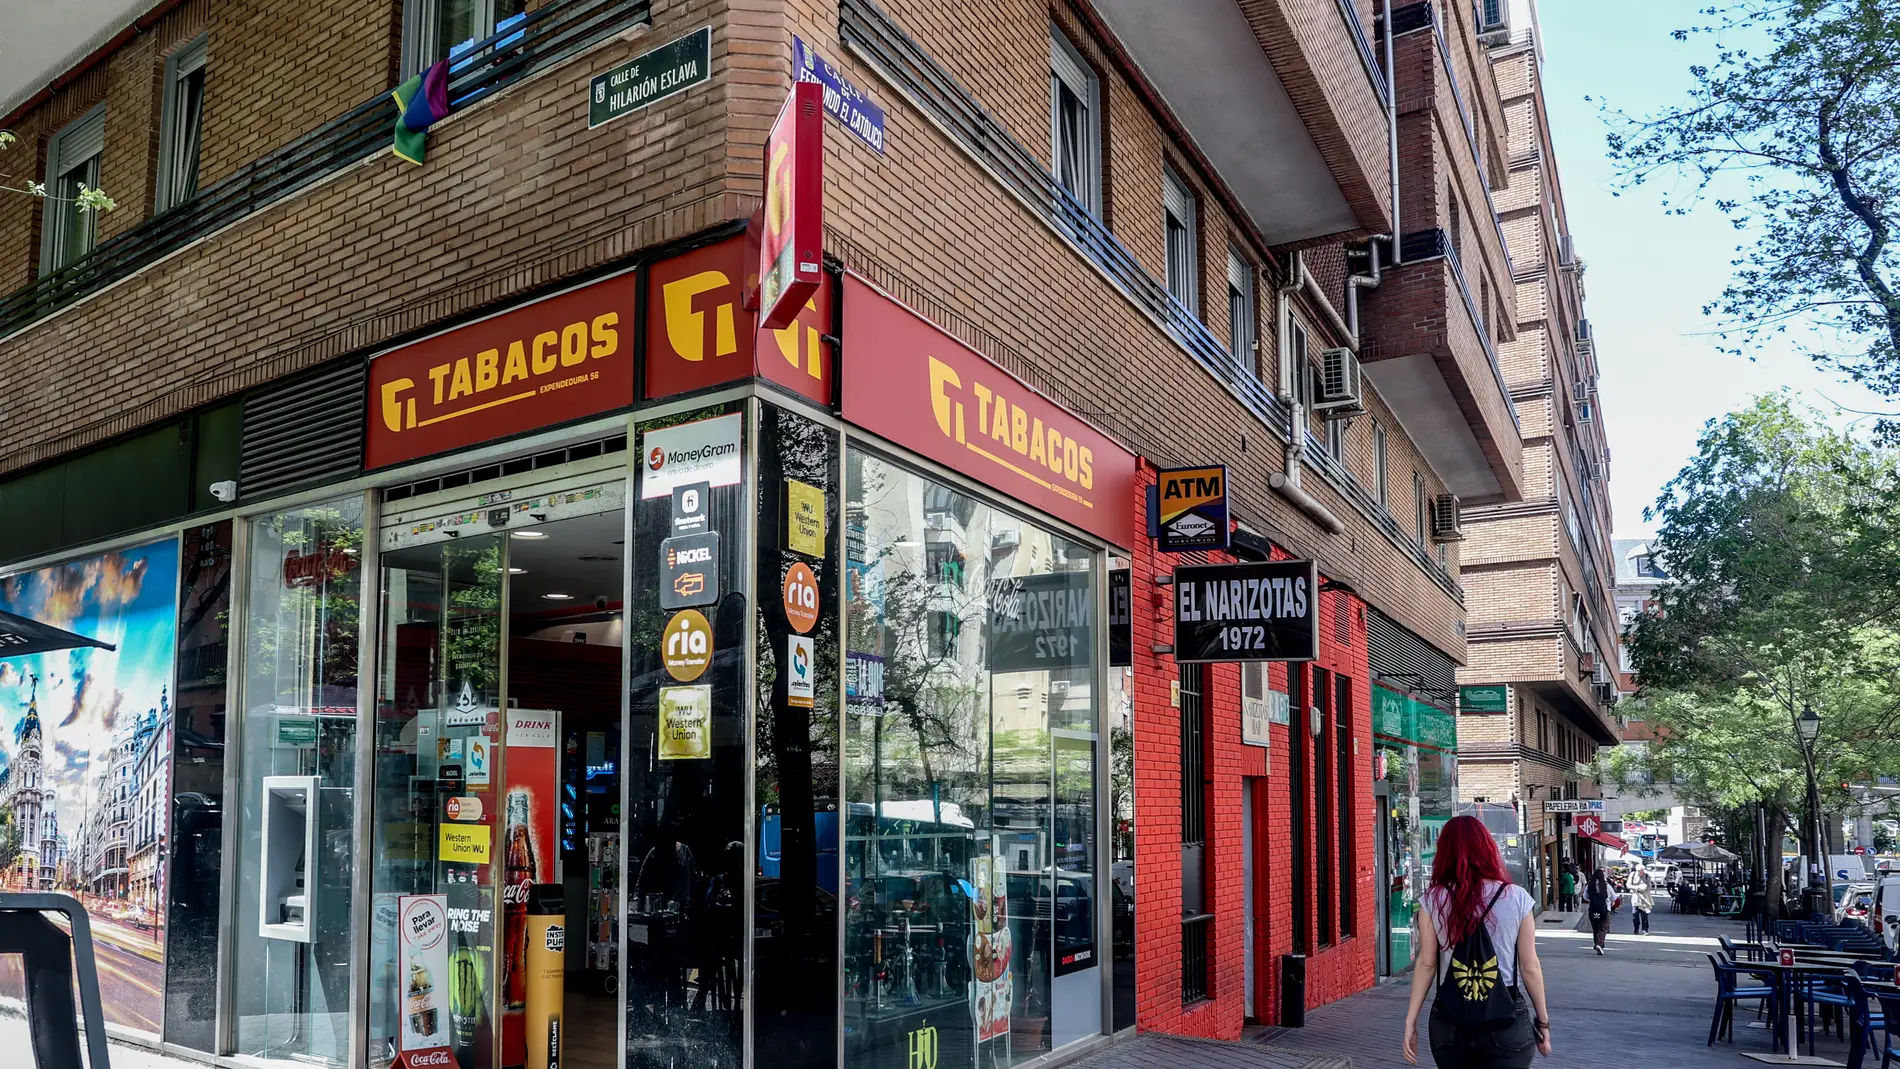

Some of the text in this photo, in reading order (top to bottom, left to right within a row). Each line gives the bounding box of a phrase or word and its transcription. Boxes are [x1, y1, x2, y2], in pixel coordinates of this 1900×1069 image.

[610, 65, 640, 87] CALLE DE
[824, 63, 863, 103] CALLE
[609, 60, 698, 112] HILARIÓN ESLAVA
[841, 87, 851, 101] DE
[840, 102, 849, 123] EL
[850, 108, 882, 150] CATÓLICO
[429, 311, 619, 405] TABACOS
[590, 371, 600, 380] 56
[974, 381, 1093, 490] TABACOS
[667, 442, 735, 464] MoneyGram
[1164, 476, 1219, 500] ATM
[794, 511, 819, 529] Western
[1175, 522, 1208, 530] Euronet
[799, 525, 816, 538] Union
[788, 571, 815, 609] ria
[1179, 576, 1307, 621] EL NARIZOTAS
[668, 619, 706, 656] ria
[1219, 626, 1266, 650] 1972
[668, 659, 684, 667] Money
[515, 720, 552, 730] DRINK
[667, 719, 702, 729] Western
[672, 730, 697, 740] Union
[448, 801, 459, 812] ria
[1545, 802, 1578, 811] PAPELERIA
[445, 832, 472, 842] Western
[453, 843, 484, 853] Union WU
[412, 910, 431, 925] Para
[447, 908, 491, 922] RING THE
[413, 916, 435, 934] llevar
[450, 920, 479, 933] NOISE
[547, 931, 563, 939] INST
[410, 1051, 450, 1067] Coca-Cola
